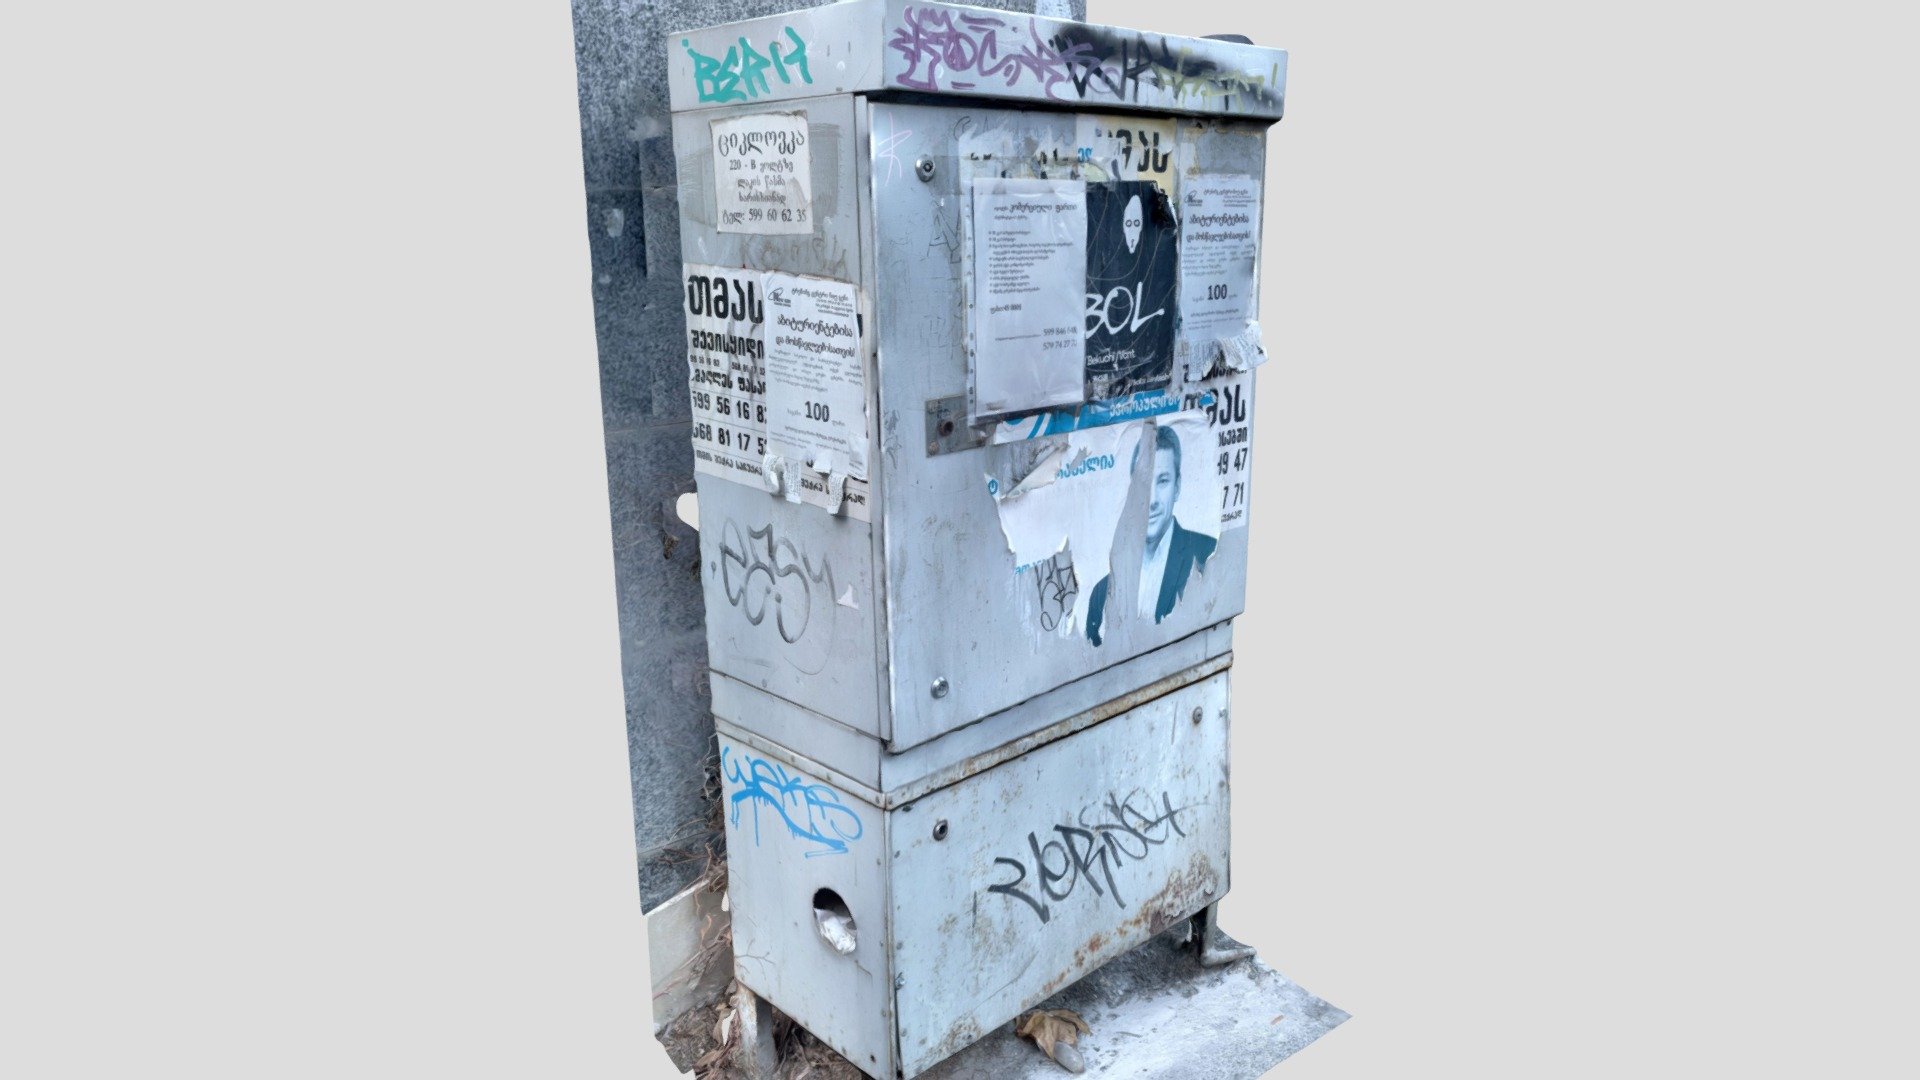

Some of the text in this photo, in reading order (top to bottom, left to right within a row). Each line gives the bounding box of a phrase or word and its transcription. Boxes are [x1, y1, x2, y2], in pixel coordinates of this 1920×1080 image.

[718, 130, 805, 157] ციკლოვკა
[729, 159, 741, 170] 220
[748, 208, 763, 221] 599
[767, 208, 778, 221] 60
[781, 208, 793, 221] 62
[688, 274, 764, 324] თმას
[1208, 284, 1228, 301] 100
[716, 395, 731, 416] 56
[736, 400, 750, 420] 16
[805, 400, 830, 423] 100
[718, 427, 731, 447] 81
[737, 432, 751, 452] 17
[758, 437, 767, 456] 5
[1233, 447, 1248, 472] 47
[1233, 481, 1245, 507] 71
